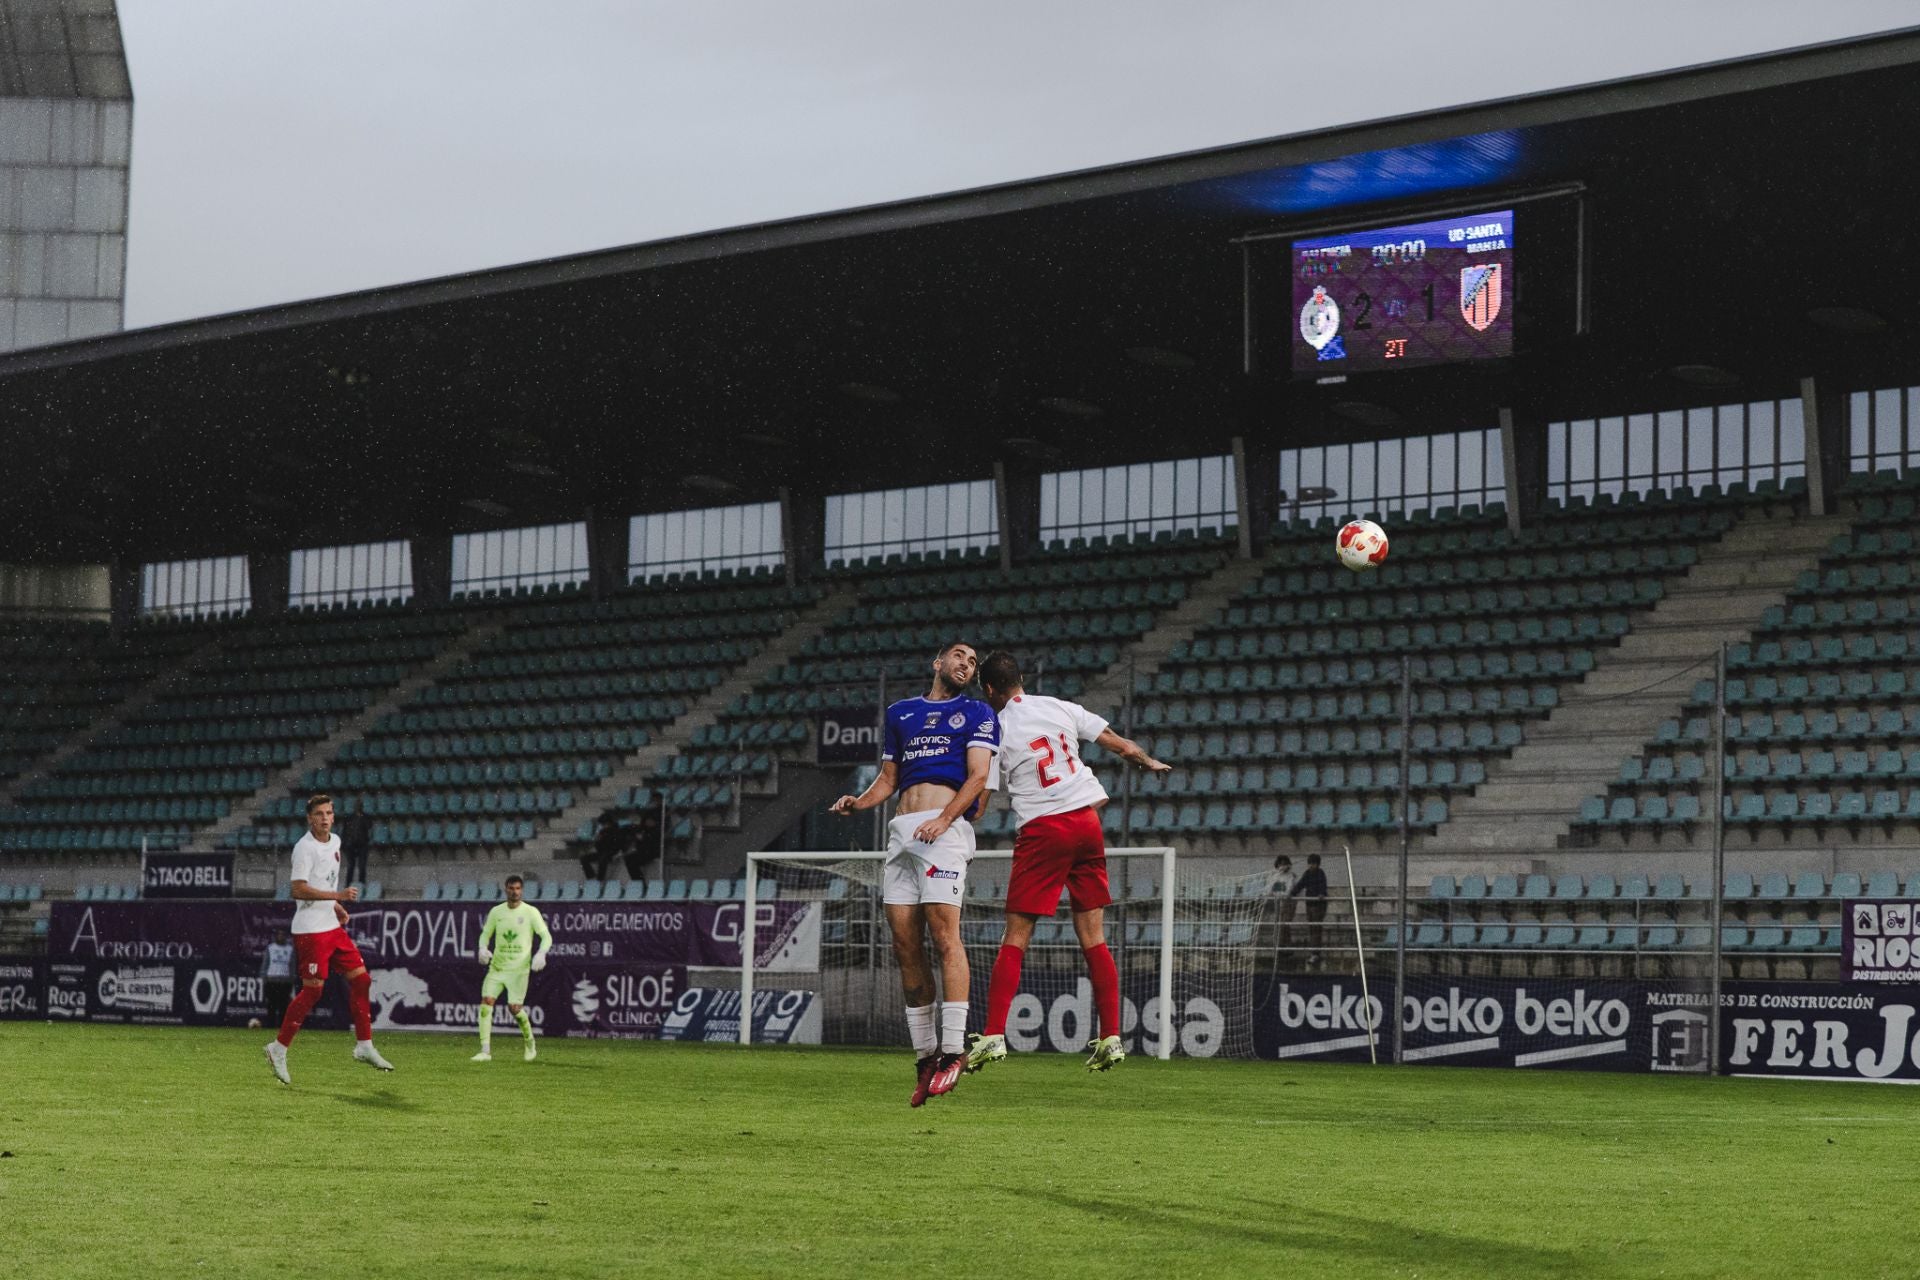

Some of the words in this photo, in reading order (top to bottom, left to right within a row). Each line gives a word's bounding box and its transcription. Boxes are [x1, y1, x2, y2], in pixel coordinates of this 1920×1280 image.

[1466, 222, 1504, 239] SANTA
[1353, 291, 1373, 330] 2
[1421, 283, 1434, 322] 1
[1385, 339, 1408, 358] 2T
[908, 735, 951, 748] uronics
[1027, 730, 1077, 789] 21
[158, 866, 192, 886] TACO
[194, 866, 229, 886] BELL
[381, 909, 475, 958] ROYAL
[551, 914, 561, 931] &
[548, 942, 586, 956] GUENOS
[48, 985, 86, 1007] Roca
[605, 968, 674, 1008] SILOÉ
[1279, 983, 1383, 1030] beko
[1515, 988, 1630, 1037] beko
[1737, 994, 1758, 1008] DE
[1760, 993, 1875, 1010] CONSTRUCCIÓN
[434, 1003, 544, 1025] TECNAMO
[1729, 1004, 1920, 1078] FERJ
